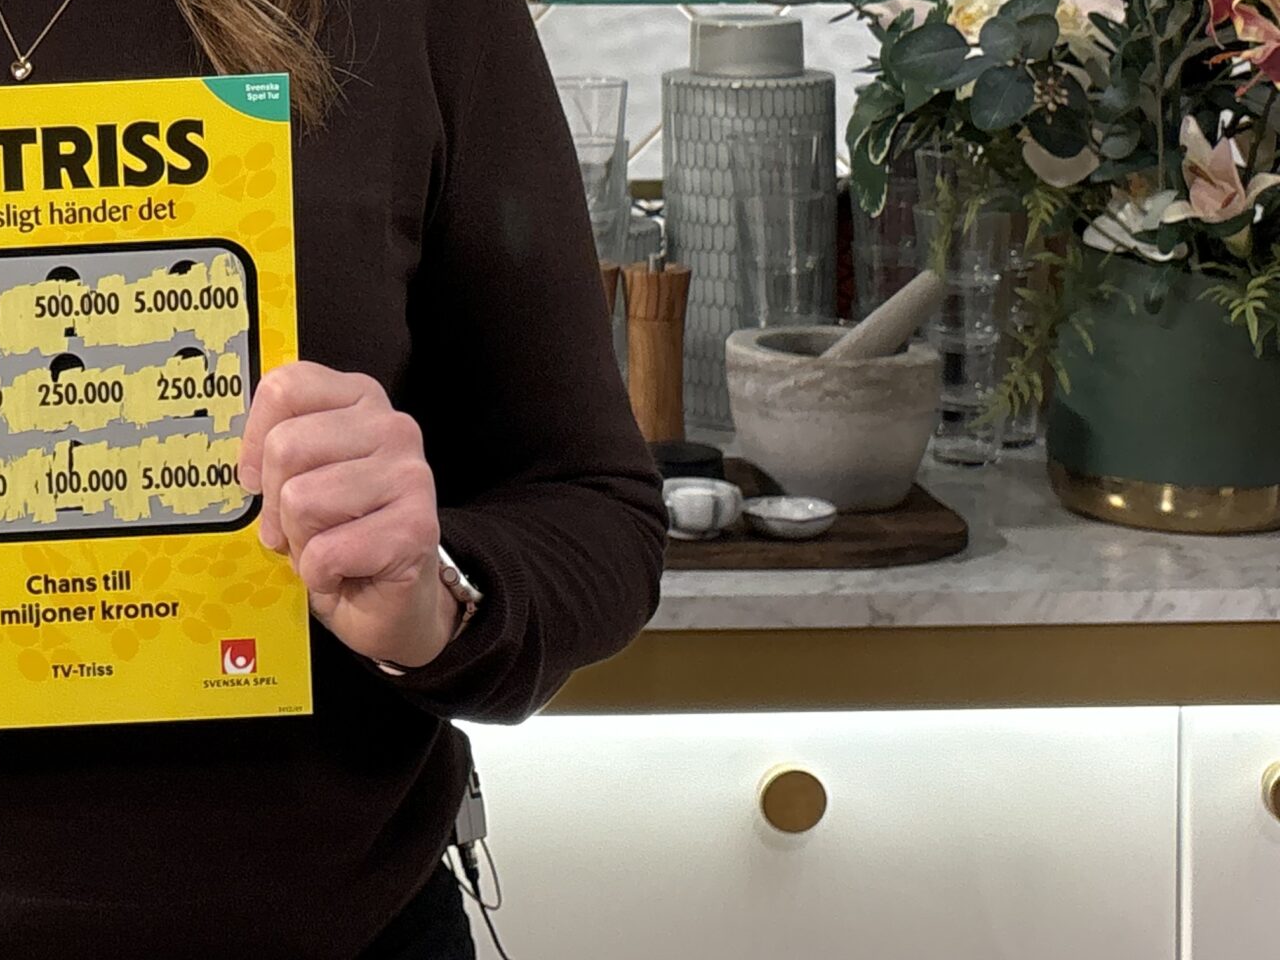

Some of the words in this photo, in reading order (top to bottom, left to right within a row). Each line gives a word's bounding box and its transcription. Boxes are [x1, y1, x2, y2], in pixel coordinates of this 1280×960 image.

[245, 83, 280, 91] Svenska
[247, 92, 266, 102] Spel
[49, 199, 133, 225] händer
[138, 197, 177, 220] det
[34, 292, 120, 318] 500.000
[133, 286, 239, 313] 5.000.000
[37, 380, 124, 407] 250.000
[156, 374, 242, 401] 250.000
[45, 468, 127, 495] 100.000
[26, 574, 98, 595] Chans
[102, 570, 131, 590] till
[0, 603, 95, 628] miljoner
[101, 600, 179, 620] kronor
[52, 662, 113, 678] TV-Triss
[203, 678, 250, 688] SVENSKA
[252, 676, 278, 686] SPEL
